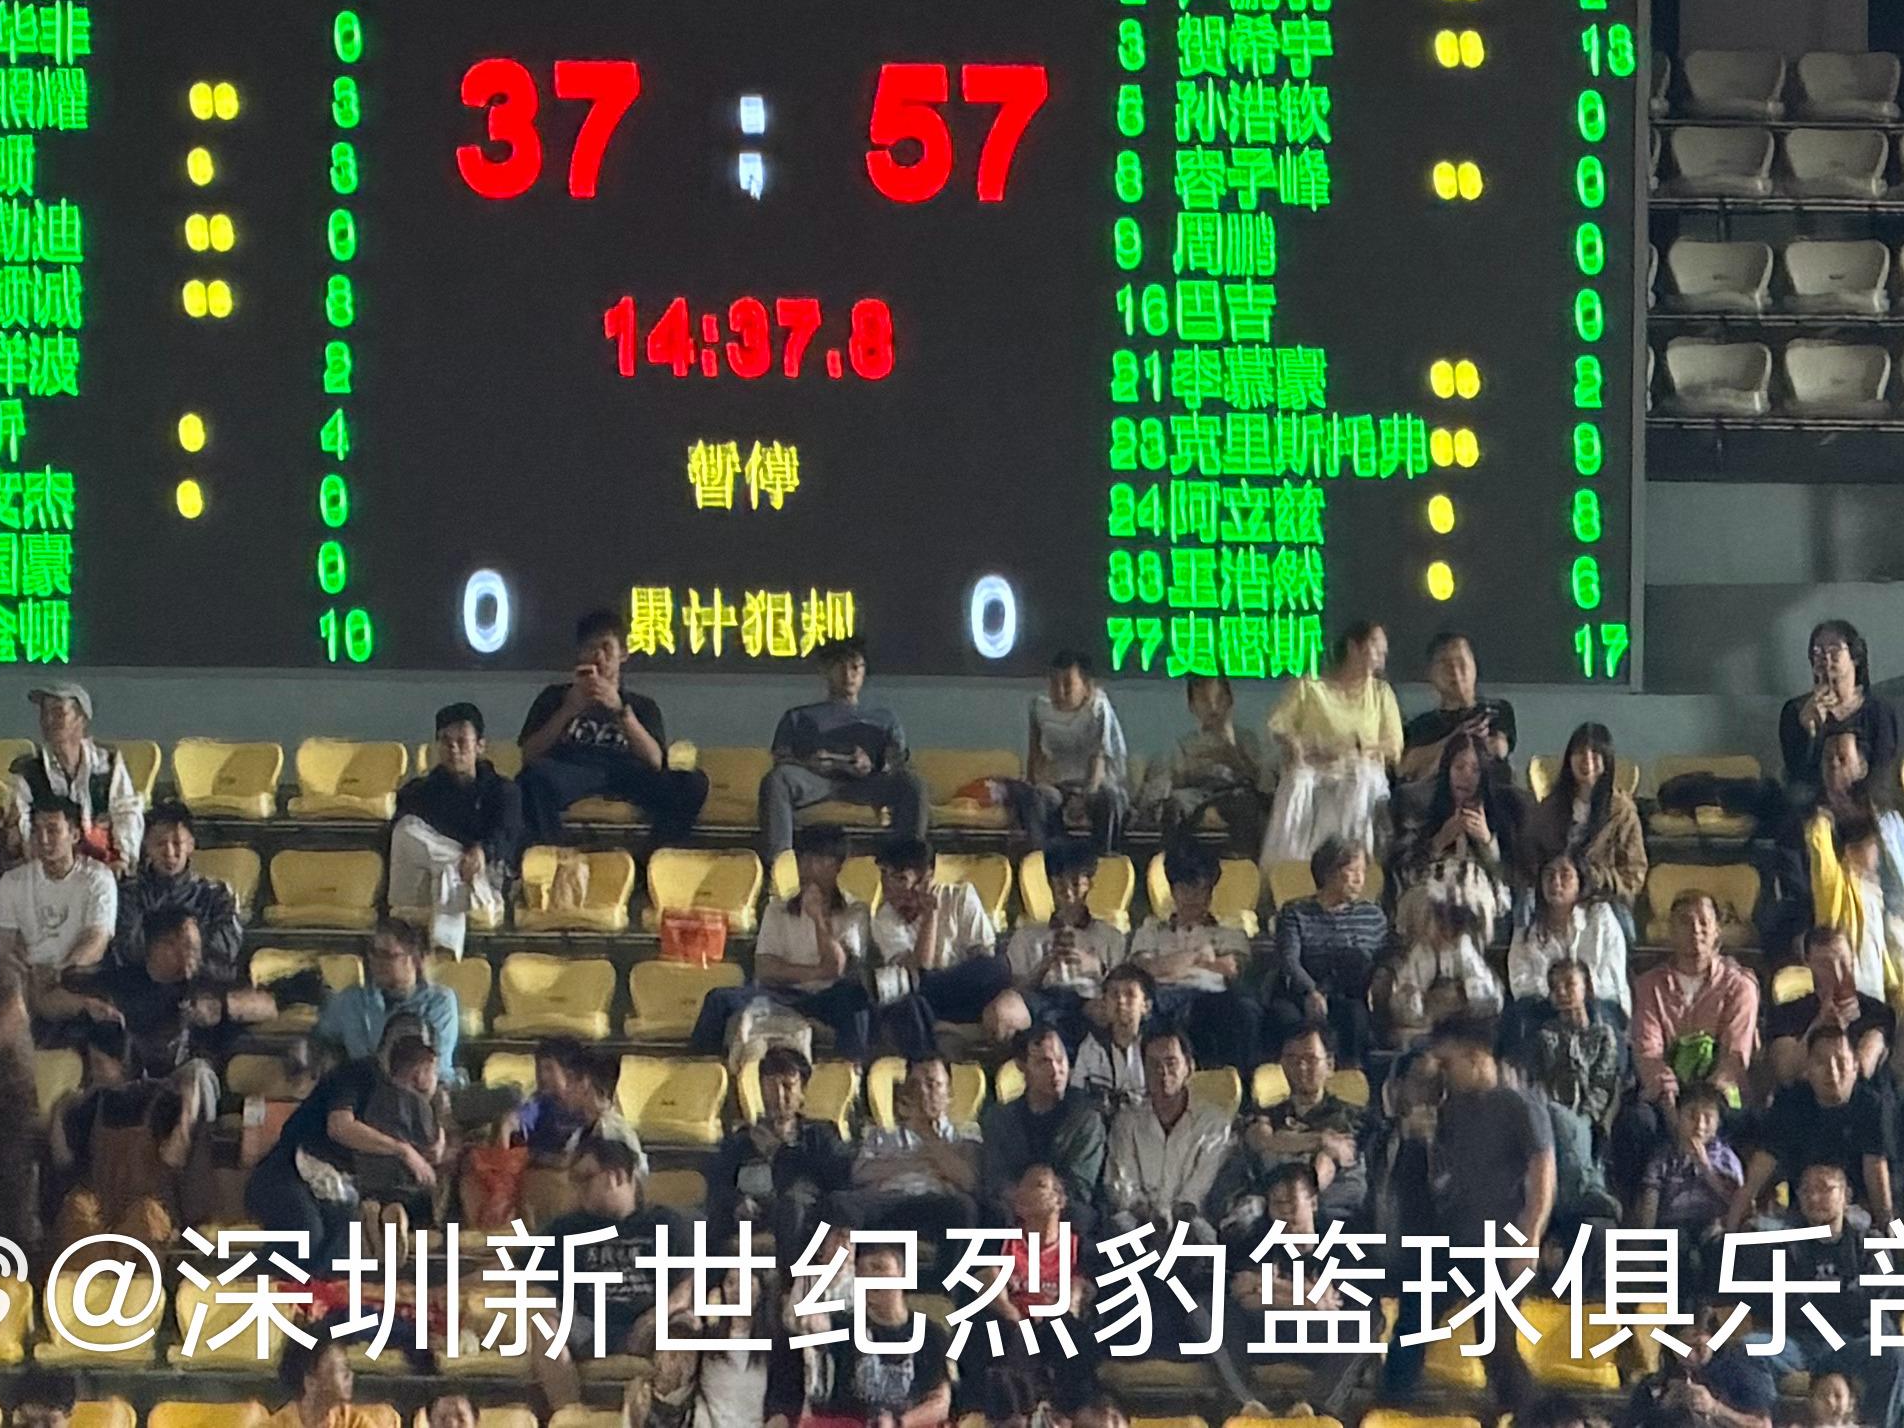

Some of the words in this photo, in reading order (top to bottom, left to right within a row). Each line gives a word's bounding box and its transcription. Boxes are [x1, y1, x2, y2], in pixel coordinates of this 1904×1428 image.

[334, 11, 362, 63] 0
[1118, 19, 1145, 71] 3
[1582, 24, 1635, 76] 13
[332, 76, 360, 128] 3
[456, 58, 640, 199] 37
[866, 63, 1048, 203] 57
[1117, 85, 1145, 136] 5
[1578, 90, 1605, 142] 0
[330, 142, 358, 194] 3
[1115, 150, 1143, 202] 8
[1577, 156, 1604, 208] 0
[328, 209, 356, 261] 0
[1114, 217, 1142, 269] 9
[1173, 213, 1276, 281] 周鹏
[1576, 223, 1604, 275] 0
[326, 275, 354, 327] 8
[1116, 284, 1168, 336] 16
[1575, 289, 1603, 341] 0
[324, 341, 352, 393] 2
[1111, 350, 1162, 402] 21
[1171, 346, 1327, 414] 李慕豪
[1574, 355, 1602, 408] 2
[320, 408, 350, 460] 4
[1110, 417, 1166, 470] 23
[1169, 413, 1431, 479] 克里斯托弗
[1574, 422, 1601, 475] 9
[320, 474, 348, 527] 0
[688, 441, 800, 510] 暂停
[1108, 483, 1165, 536] 24
[1573, 489, 1601, 542] 8
[318, 541, 346, 594] 0
[1108, 550, 1164, 603] 33
[1571, 556, 1600, 609] 6
[320, 608, 373, 662] 10
[464, 570, 509, 652] 0
[971, 576, 1016, 658] 0
[1107, 617, 1163, 671] 77
[1166, 612, 1324, 680] 史密斯
[1575, 624, 1628, 677] 17
